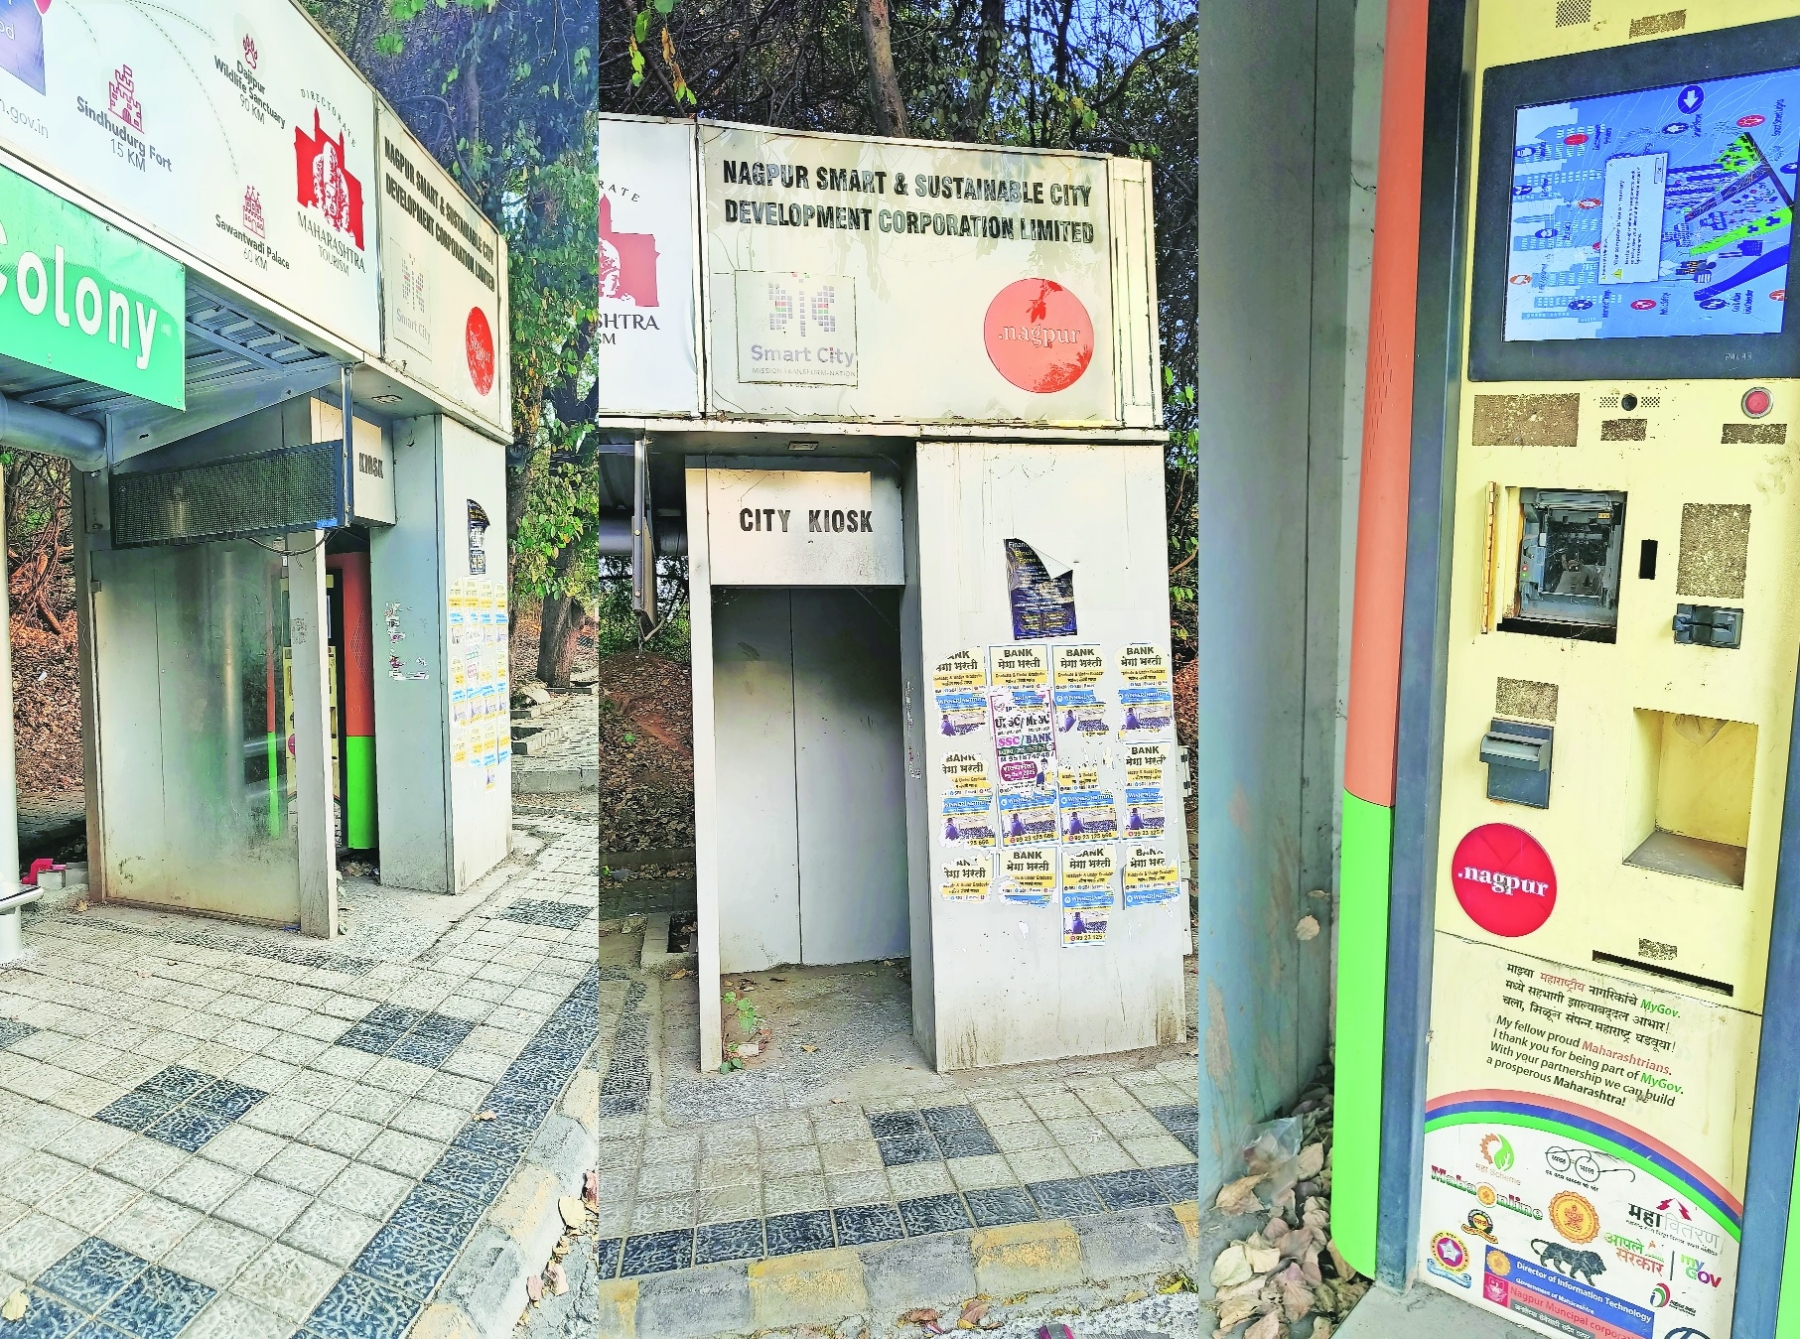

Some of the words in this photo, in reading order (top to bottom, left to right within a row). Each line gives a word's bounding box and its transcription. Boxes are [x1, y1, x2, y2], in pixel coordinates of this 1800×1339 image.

[214, 54, 247, 94] Wildlife
[248, 85, 286, 130] Sanctuary
[236, 59, 266, 95] Dajipur
[239, 93, 250, 113] 90
[252, 105, 265, 125] KM
[300, 88, 357, 148] DIRECTORATE
[77, 95, 146, 158] Sindhudurg
[149, 143, 173, 173] Fort
[110, 138, 124, 158] 15
[127, 147, 147, 173] KM
[384, 136, 415, 186] NAGPUR
[416, 170, 438, 209] SMART
[440, 196, 445, 216] &
[446, 202, 482, 253] SUSTAINABLE
[723, 159, 809, 189] NAGPUR
[816, 166, 887, 194] SMART
[894, 172, 909, 196] &
[915, 173, 1044, 204] SUSTAINABLE
[1050, 183, 1092, 207] CITY
[386, 172, 434, 236] DEVELOPMENT
[436, 222, 474, 274] CORPORATION
[725, 199, 872, 231] DEVELOPMENT
[878, 208, 1014, 240] CORPORATION
[1020, 217, 1094, 244] LIMITED
[215, 213, 265, 252] Sawantwadi
[266, 246, 290, 271] Palace
[297, 211, 366, 274] MAHARASHTRA
[243, 249, 253, 263] 60
[254, 255, 268, 273] KM
[318, 244, 351, 278] TOURISM
[0, 219, 158, 371] olony
[396, 308, 418, 332] Smart
[418, 317, 431, 345] City
[751, 344, 812, 362] Smart
[817, 346, 854, 368] City
[359, 452, 384, 479] KIOSK
[739, 507, 791, 533] CITY
[808, 508, 874, 534] KIOSK
[1004, 649, 1033, 658] BANK
[1060, 658, 1077, 668] मेगा
[1080, 657, 1102, 668] भरती
[1066, 648, 1094, 656] BANK
[1126, 647, 1154, 655] BANK
[1131, 746, 1160, 755] BANK
[1013, 851, 1043, 860] BANK
[1458, 866, 1549, 897] .nagpur
[1505, 979, 1525, 993] मध्ये
[1528, 986, 1564, 1004] सहभागी
[1507, 963, 1535, 978] माझ्या
[1540, 972, 1586, 993] महाराष्ट्रीय
[1589, 984, 1638, 1007] नागरिकांचे
[1640, 999, 1681, 1019] MyGov.
[1496, 1015, 1512, 1030] My
[1514, 1019, 1546, 1038] fellow
[1547, 1030, 1581, 1048] proud
[1582, 1041, 1672, 1076] Maharashtrians.
[1595, 1023, 1632, 1043] महाराष्ट्र
[1490, 1041, 1514, 1057] With
[1516, 1050, 1539, 1065] your
[1540, 1056, 1603, 1086] partnership
[1604, 1078, 1621, 1090] we
[1623, 1084, 1643, 1097] can
[1646, 1088, 1675, 1107] build
[1493, 1028, 1497, 1038] I
[1499, 1030, 1528, 1047] thank
[1529, 1040, 1549, 1054] you
[1551, 1045, 1568, 1060] for
[1568, 1050, 1600, 1071] being
[1601, 1061, 1625, 1078] part
[1627, 1069, 1640, 1080] of
[1640, 1072, 1684, 1095] MyGov.
[1486, 1057, 1493, 1065] a
[1494, 1058, 1552, 1083] prosperous
[1553, 1075, 1626, 1107] Maharashtra!
[1475, 1163, 1489, 1174] महा
[1490, 1168, 1521, 1186] Scheme
[1604, 1232, 1644, 1255] आपले
[1616, 1247, 1664, 1277] सरकार
[1510, 1286, 1544, 1307] Nagpur
[1545, 1301, 1589, 1326] Muncipal
[1515, 1277, 1550, 1297] Government
[1551, 1291, 1558, 1299] of
[1558, 1294, 1595, 1315] Maharashtra
[1517, 1261, 1547, 1279] Director
[1548, 1272, 1557, 1283] of
[1557, 1277, 1603, 1303] Information
[1604, 1297, 1652, 1323] Technology
